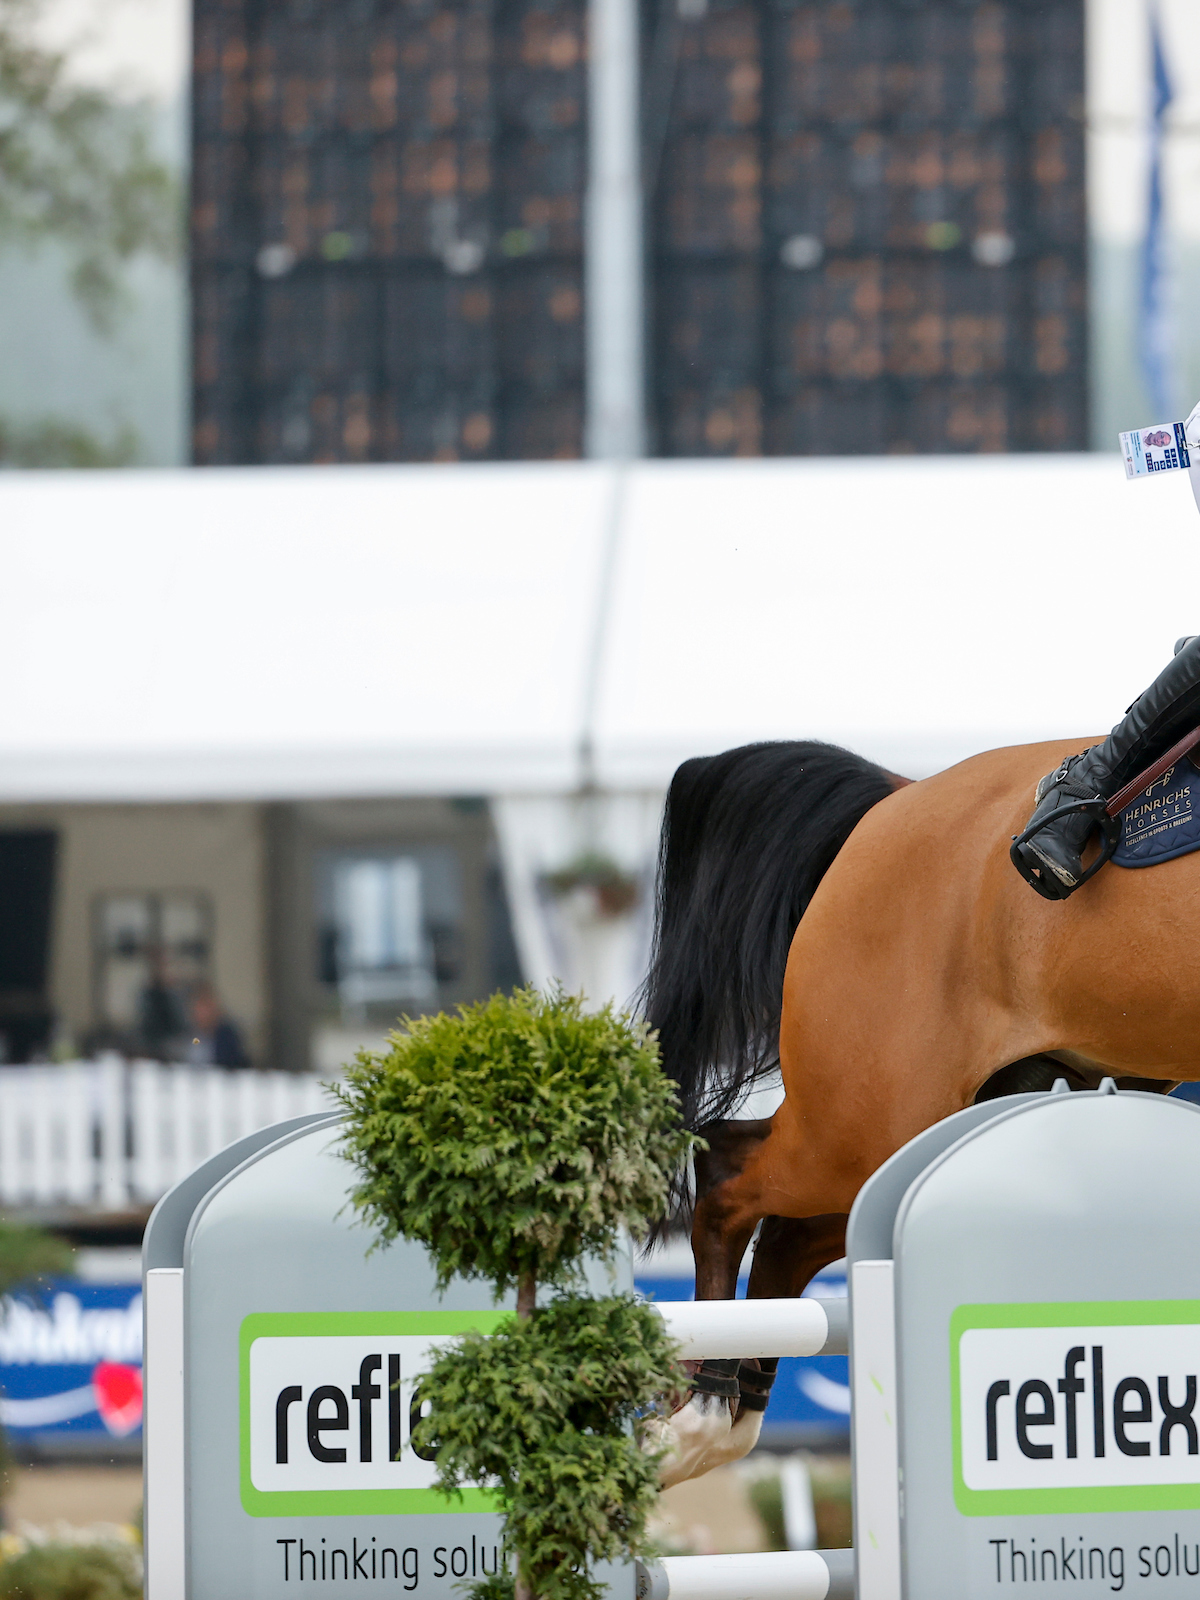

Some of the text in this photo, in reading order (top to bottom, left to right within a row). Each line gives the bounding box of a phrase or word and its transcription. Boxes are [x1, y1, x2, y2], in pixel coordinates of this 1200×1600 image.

[1125, 786, 1191, 823] HEINRICHS
[1125, 799, 1191, 834] HORSES
[986, 1345, 1199, 1461] reflex
[276, 1536, 419, 1591] Thinking
[988, 1536, 1125, 1592] Thinking
